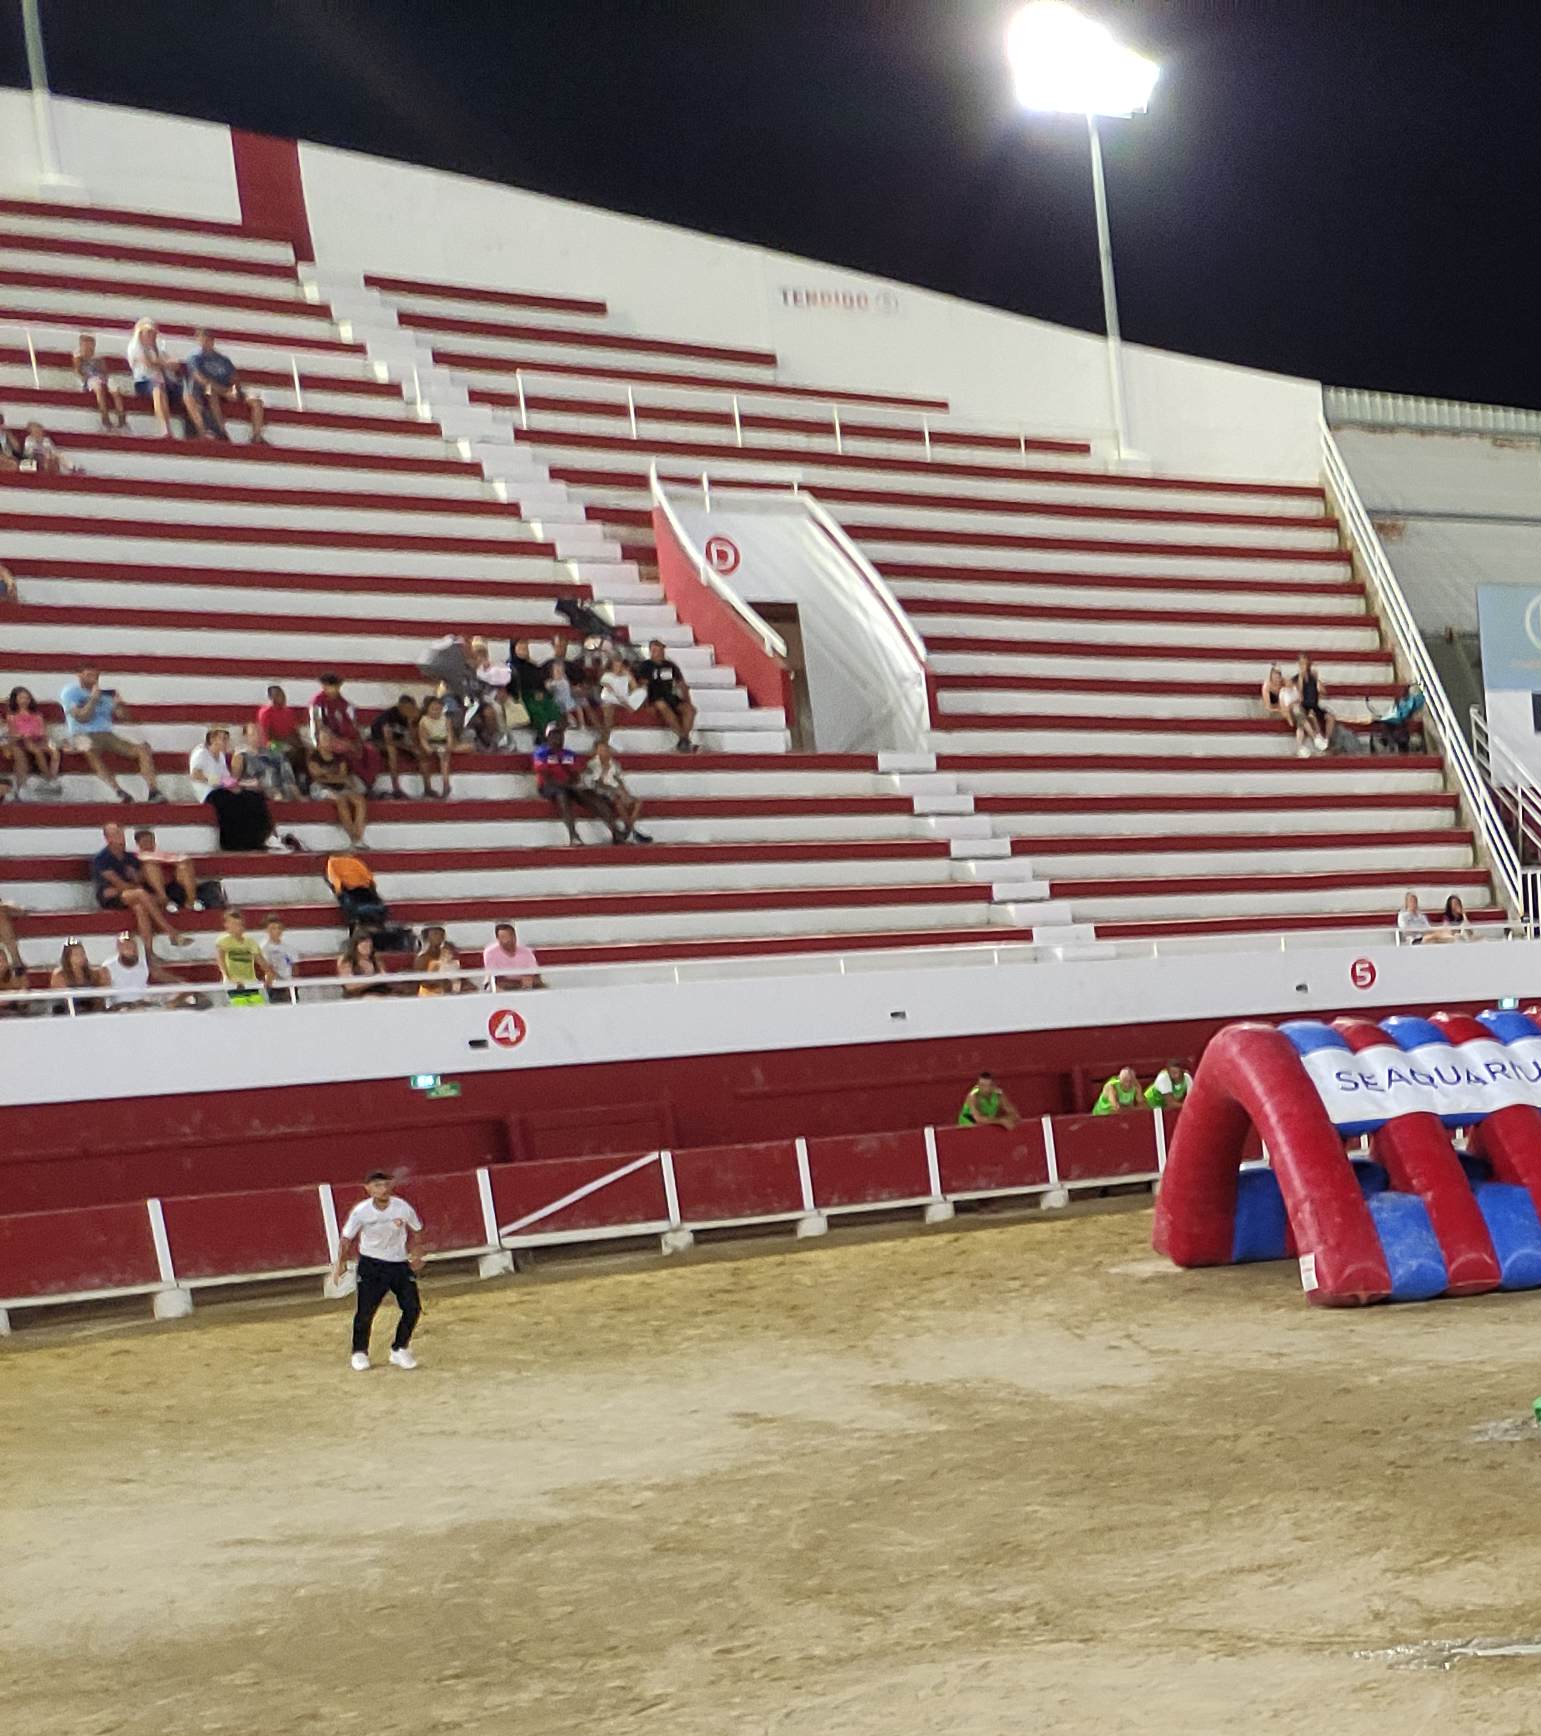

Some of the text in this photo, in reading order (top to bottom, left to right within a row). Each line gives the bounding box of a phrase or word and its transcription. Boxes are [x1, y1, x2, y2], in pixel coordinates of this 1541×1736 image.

[710, 541, 733, 570] D
[1357, 961, 1371, 984] 5
[495, 1013, 519, 1042] 4
